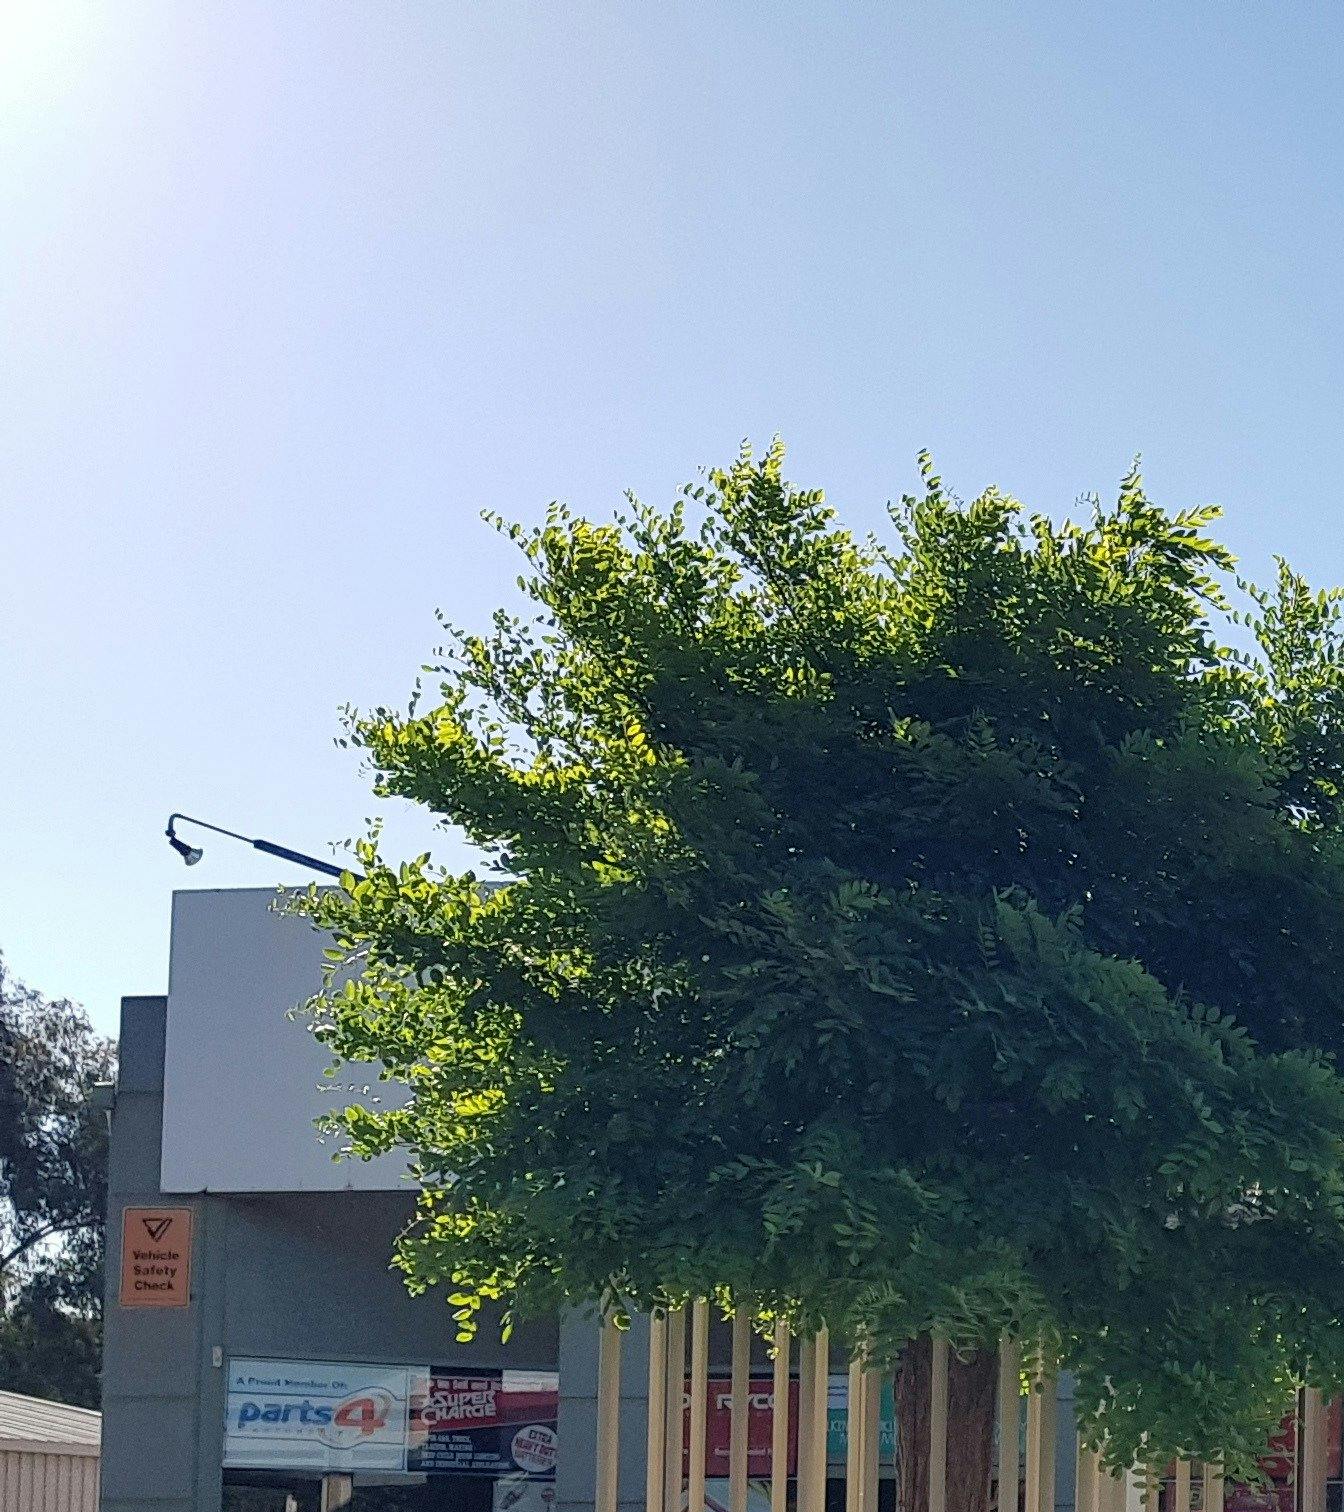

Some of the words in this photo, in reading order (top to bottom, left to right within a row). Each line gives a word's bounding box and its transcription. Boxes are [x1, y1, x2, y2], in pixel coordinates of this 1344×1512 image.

[132, 1249, 180, 1261] Vehicle
[133, 1264, 178, 1279] Safety
[134, 1280, 175, 1291] Check
[429, 1388, 497, 1408] SUPER
